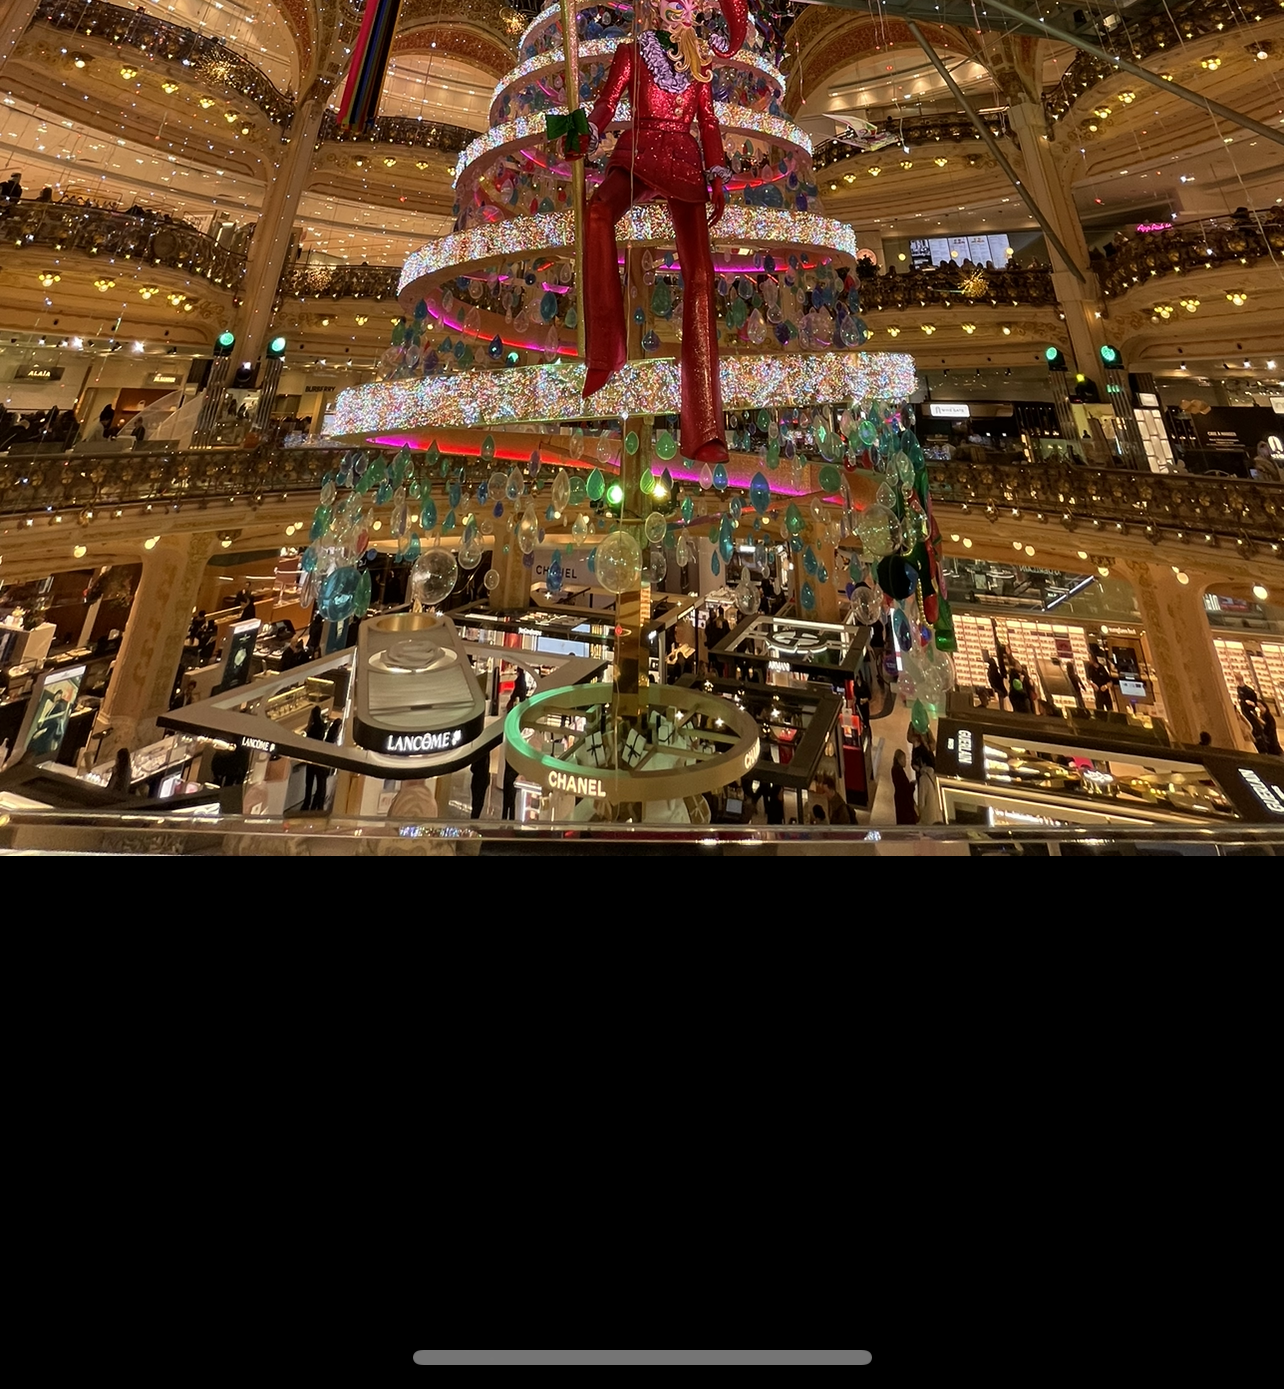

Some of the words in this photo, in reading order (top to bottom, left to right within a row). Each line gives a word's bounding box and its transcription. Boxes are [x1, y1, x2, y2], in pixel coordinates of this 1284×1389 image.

[535, 564, 577, 579] CHEL
[387, 732, 451, 750] LANCÔME
[548, 770, 607, 797] CHANEL
